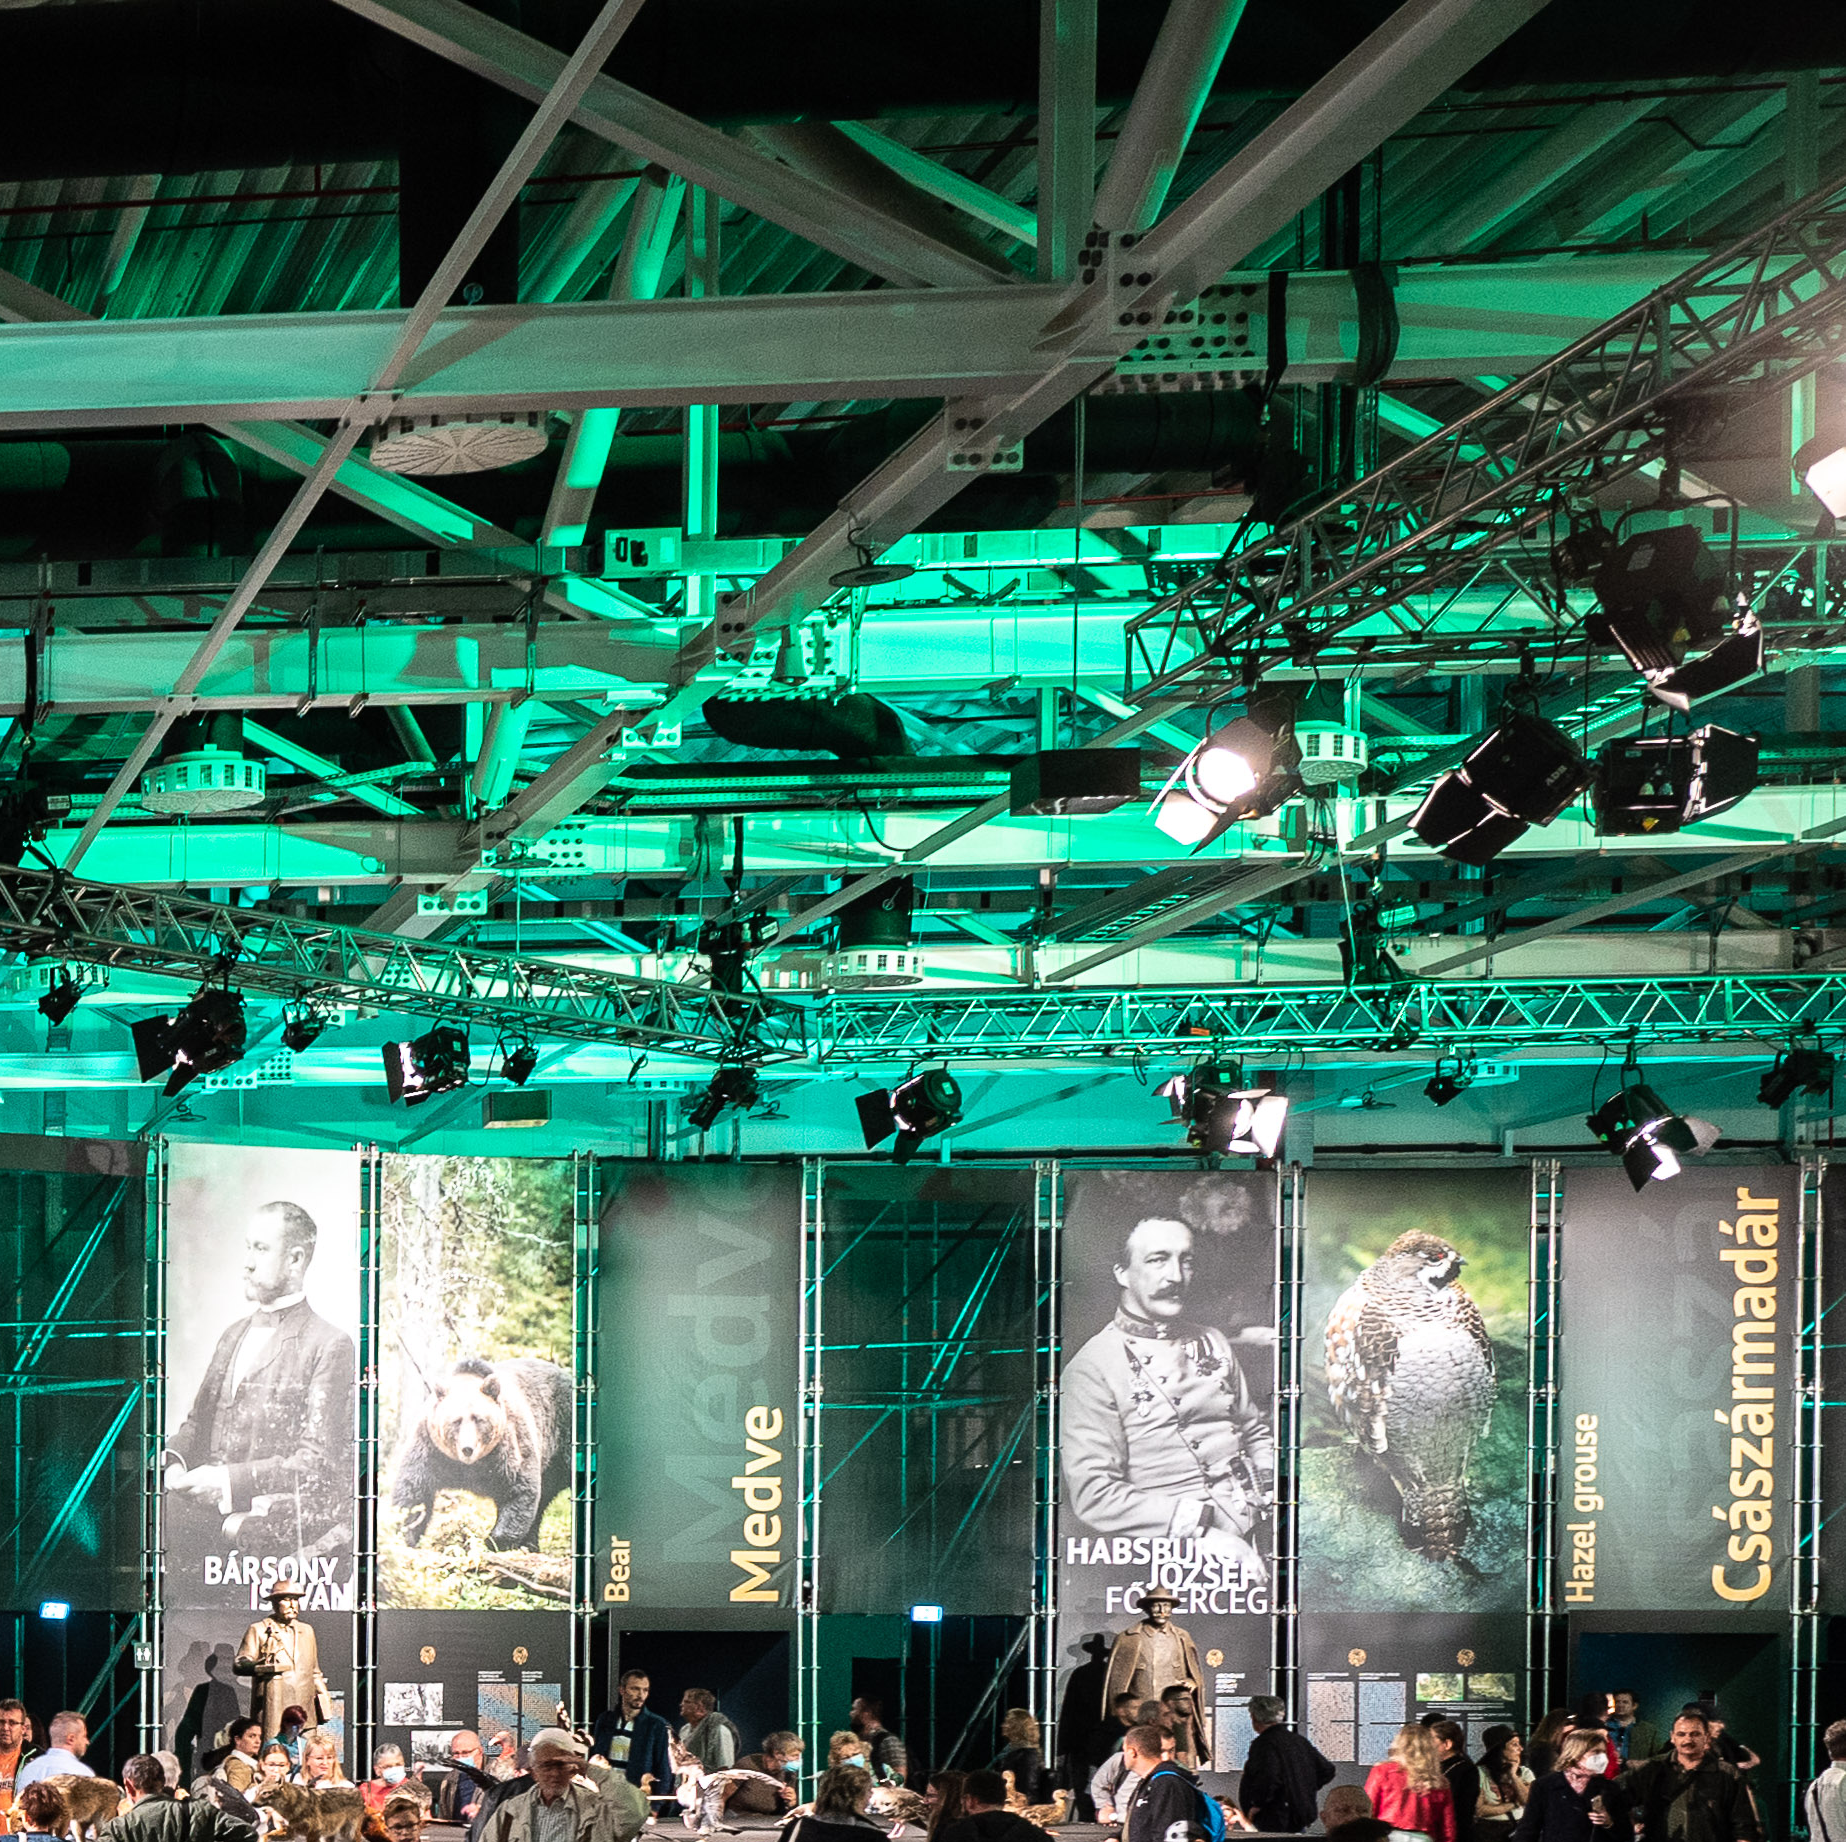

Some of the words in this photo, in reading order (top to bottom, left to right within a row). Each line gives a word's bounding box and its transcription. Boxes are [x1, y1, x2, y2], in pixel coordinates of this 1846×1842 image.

[1711, 1185, 1781, 1603] Császármadár
[1573, 1413, 1606, 1515] grouse
[729, 1404, 784, 1603] Medve
[204, 1550, 339, 1586] BÁRSONY
[249, 1577, 351, 1612] ISVÁN
[602, 1535, 631, 1603] Bear
[1105, 1581, 1268, 1615] FŐERCEG
[1565, 1519, 1596, 1603] Hazel
